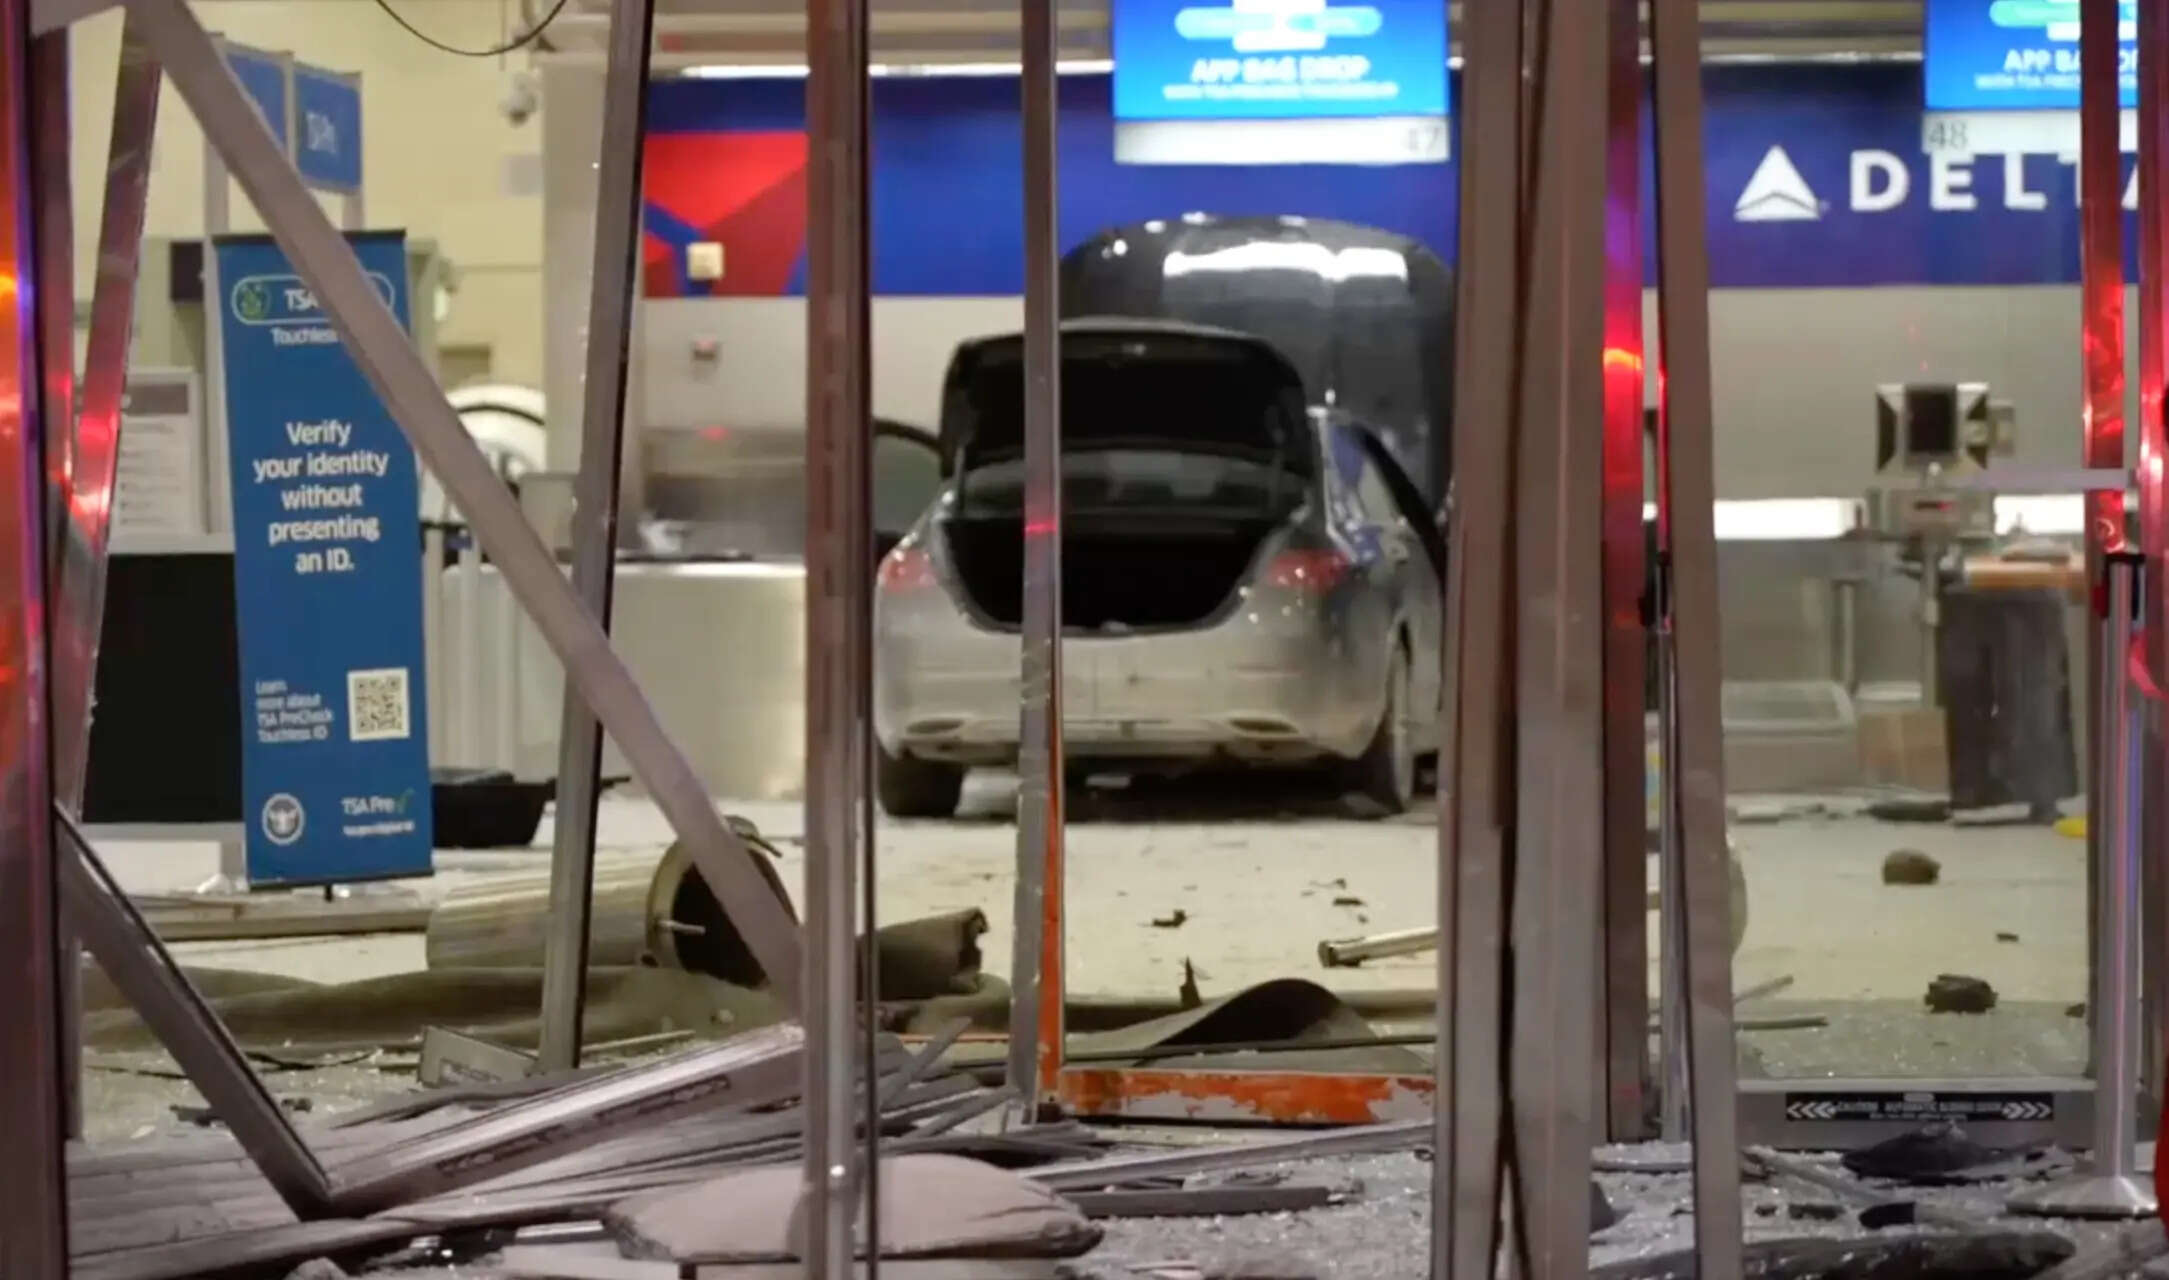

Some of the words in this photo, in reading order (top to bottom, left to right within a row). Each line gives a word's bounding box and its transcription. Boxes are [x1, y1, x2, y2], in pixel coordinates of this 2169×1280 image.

[2003, 48, 2050, 72] APP
[2055, 48, 2081, 72] BA
[1928, 122, 1969, 149] 48
[1850, 149, 2138, 212] DEL
[284, 289, 319, 311] TSA
[286, 420, 351, 448] Verify
[253, 456, 302, 483] your
[307, 451, 389, 477] identity
[281, 483, 363, 510] without
[268, 515, 381, 546] presenting
[295, 553, 322, 574] an
[327, 549, 354, 571] ID.
[341, 797, 369, 815] TSA
